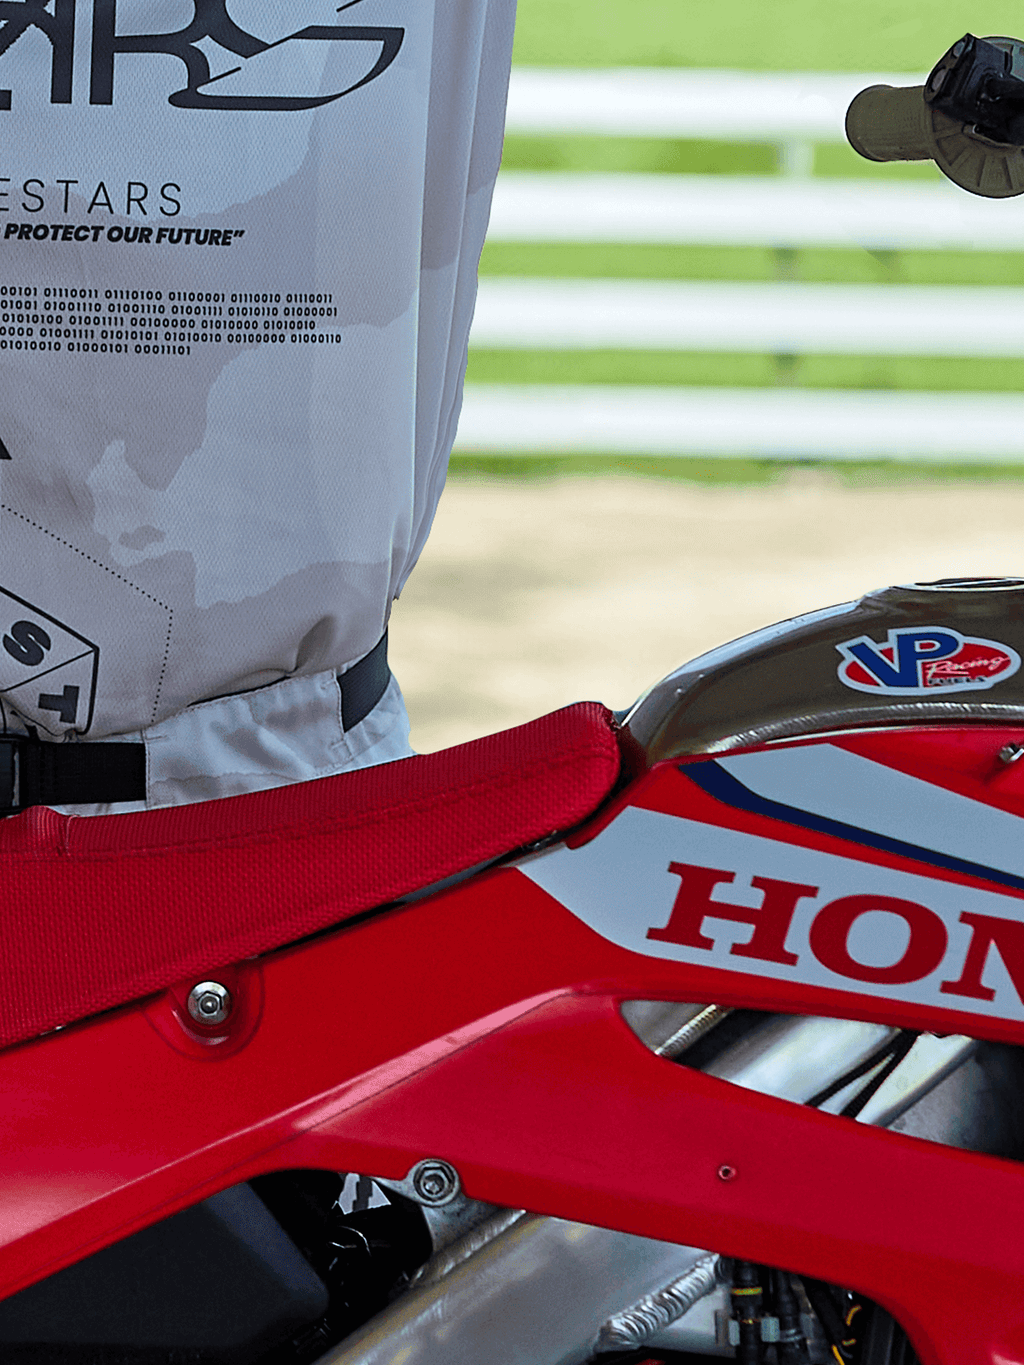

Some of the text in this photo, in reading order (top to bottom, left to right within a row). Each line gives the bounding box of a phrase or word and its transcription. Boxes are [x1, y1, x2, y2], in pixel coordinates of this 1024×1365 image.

[3, 222, 105, 243] PROTECT
[106, 225, 154, 244] OUR
[43, 287, 99, 299] 01110011
[104, 289, 163, 302] 01110100
[168, 291, 226, 304] 01100001
[230, 292, 282, 304] 01110010
[285, 293, 333, 304] 01110011
[43, 300, 102, 313] 01001110
[107, 302, 166, 315] 01001110
[170, 304, 223, 317] 01001111
[227, 306, 279, 317] 01010110
[282, 306, 338, 318] 01000001
[1, 312, 64, 325] 01010100
[68, 314, 125, 327] 01001111
[129, 316, 196, 330] 00100000
[200, 319, 259, 331] 01010000
[262, 319, 316, 331] 01010010
[39, 327, 95, 340] 01001111
[100, 329, 159, 342] 01010101
[163, 330, 222, 343] 01010010
[226, 332, 286, 344] 00100000
[290, 333, 342, 344] 01000110
[0, 339, 62, 352] 01010010
[66, 341, 129, 354] 01000101
[133, 343, 191, 356] 00011101
[840, 629, 961, 688] VP
